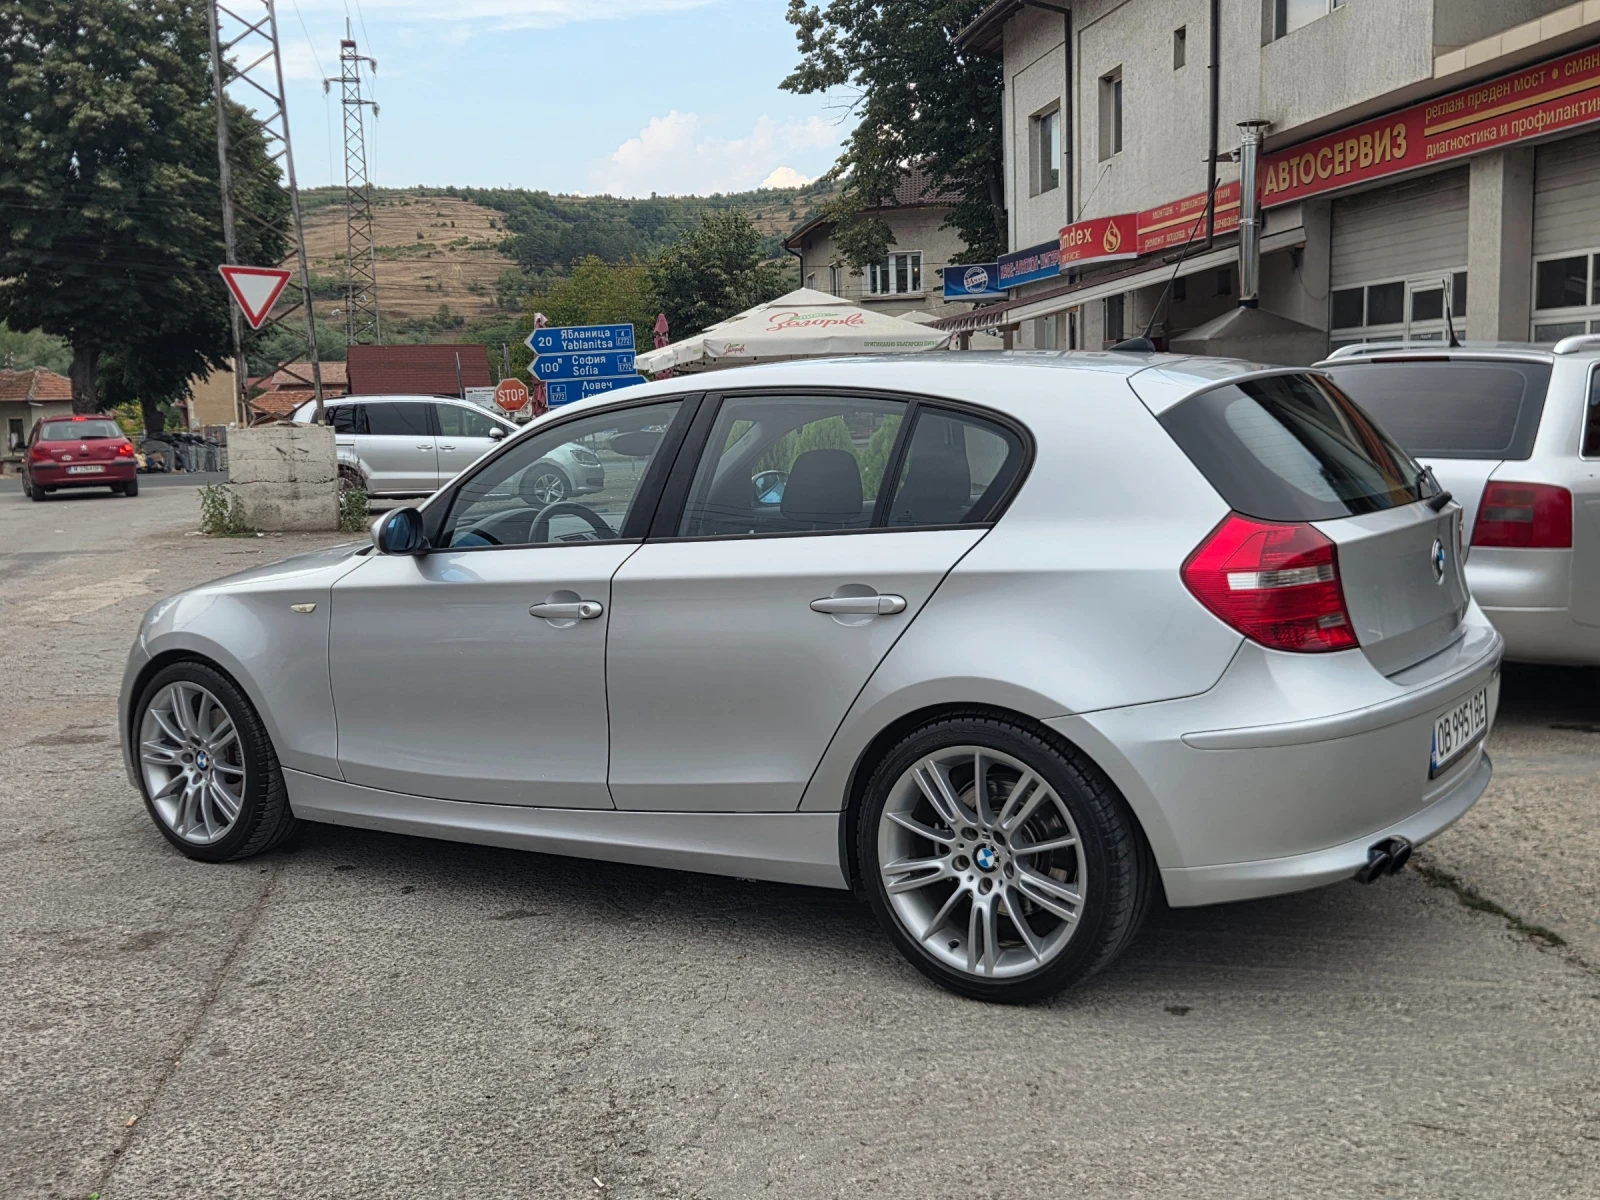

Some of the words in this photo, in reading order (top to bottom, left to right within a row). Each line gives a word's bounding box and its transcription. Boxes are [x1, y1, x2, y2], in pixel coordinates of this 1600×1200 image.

[1425, 96, 1465, 124] реглаж
[1467, 82, 1511, 110] преден
[1514, 71, 1546, 92] мост
[1426, 128, 1497, 160] диагностика
[1500, 123, 1508, 137] и
[1264, 123, 1407, 195] АВТОСЕРВИЗ
[560, 329, 611, 340] Ябланица
[538, 337, 553, 347] 20
[561, 339, 613, 350] Yablanitsa
[617, 337, 630, 345] E772
[572, 355, 606, 365] София
[540, 362, 559, 373] 100
[572, 366, 599, 376] Sofia
[582, 381, 613, 390] Ловеч
[498, 388, 525, 402] STOP
[551, 393, 565, 401] E772
